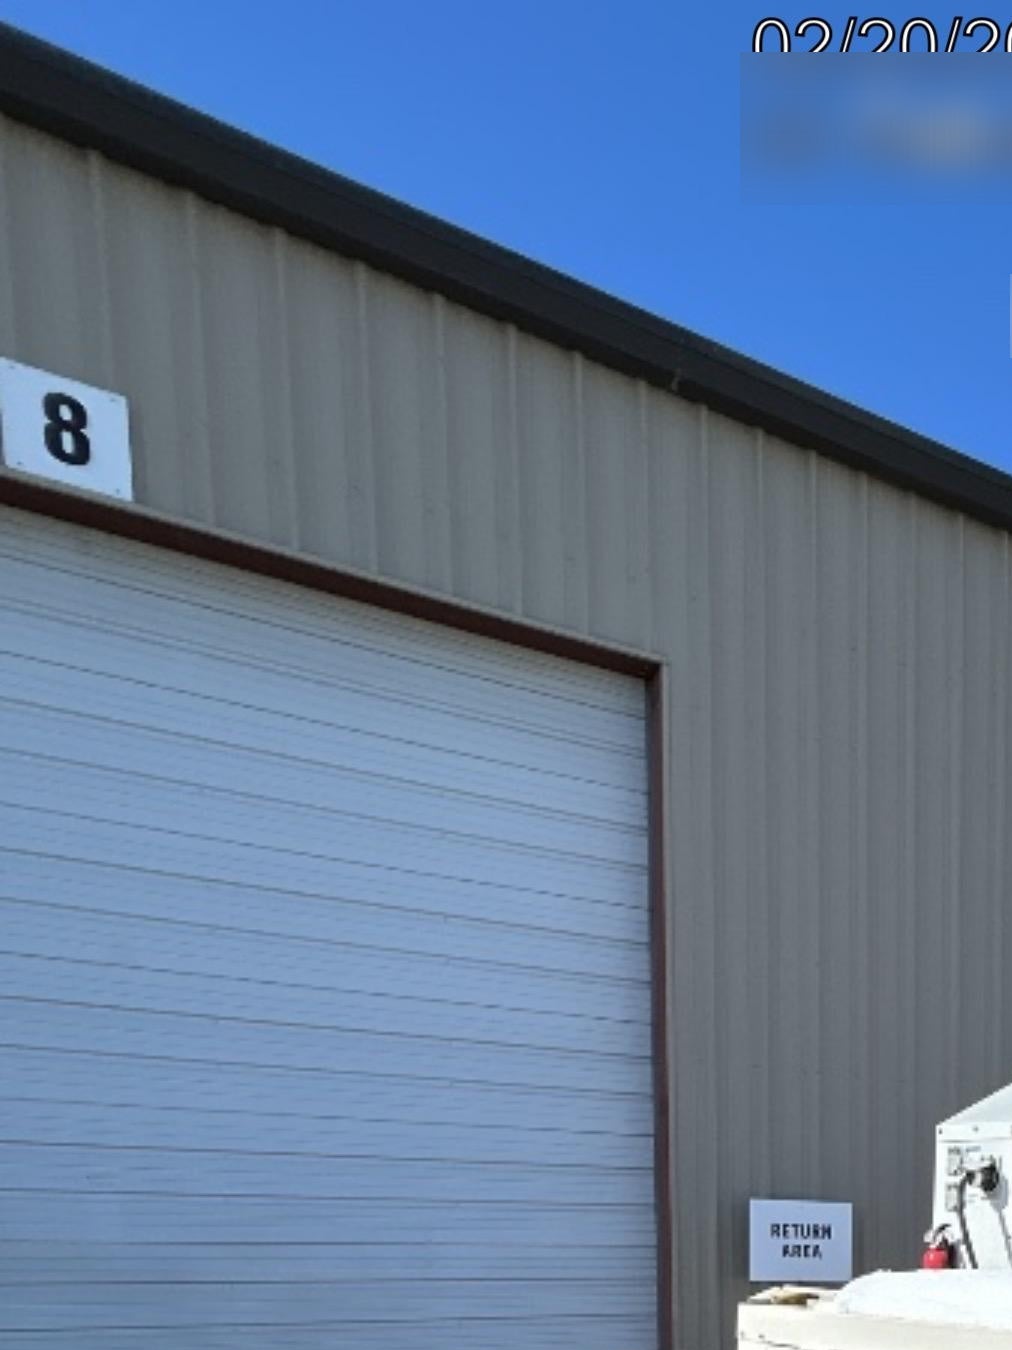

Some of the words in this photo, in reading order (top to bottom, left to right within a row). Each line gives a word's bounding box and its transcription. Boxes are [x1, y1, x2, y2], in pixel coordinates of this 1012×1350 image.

[43, 391, 91, 466] 8
[770, 1223, 832, 1240] RETURN
[782, 1244, 822, 1260] AREA
